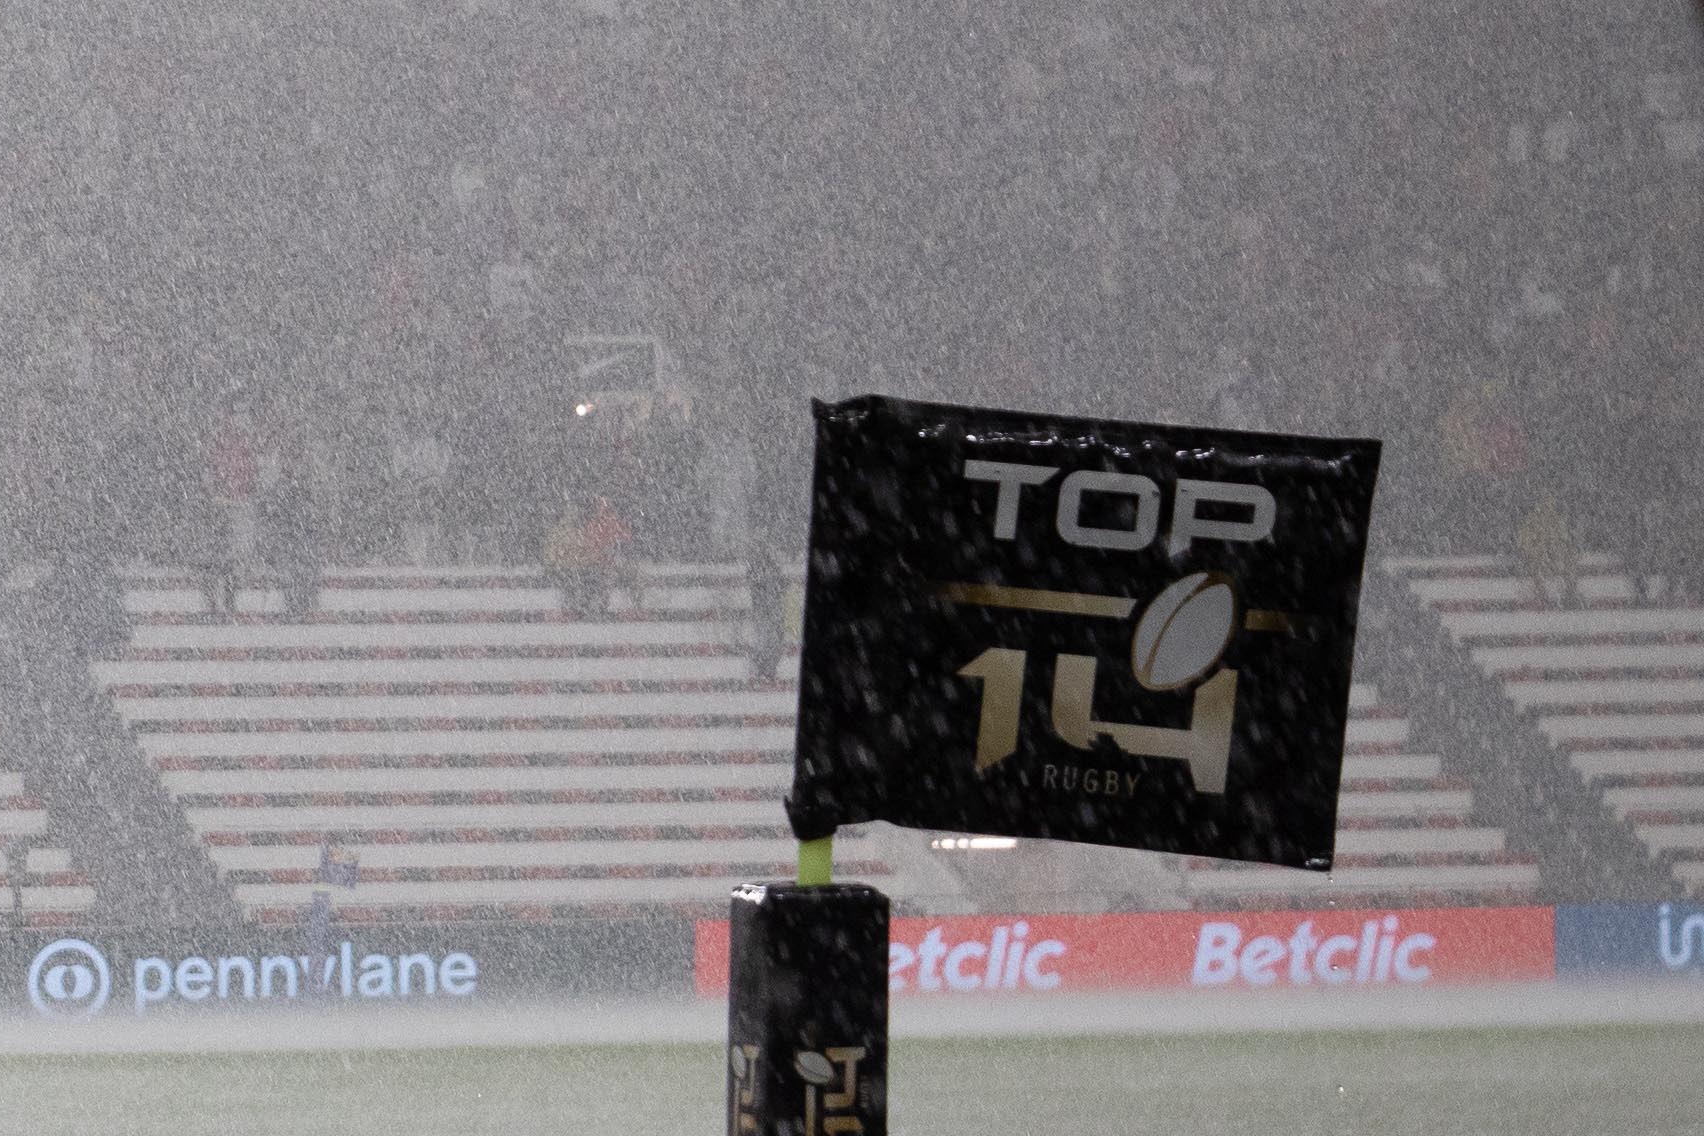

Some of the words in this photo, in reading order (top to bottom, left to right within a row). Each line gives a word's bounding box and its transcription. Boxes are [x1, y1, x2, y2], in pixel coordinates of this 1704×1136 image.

[963, 458, 1277, 559] TOP
[956, 646, 1238, 795] 14
[1042, 763, 1141, 798] RUGBY
[888, 920, 1067, 990] etclic
[1193, 916, 1436, 986] Betclic
